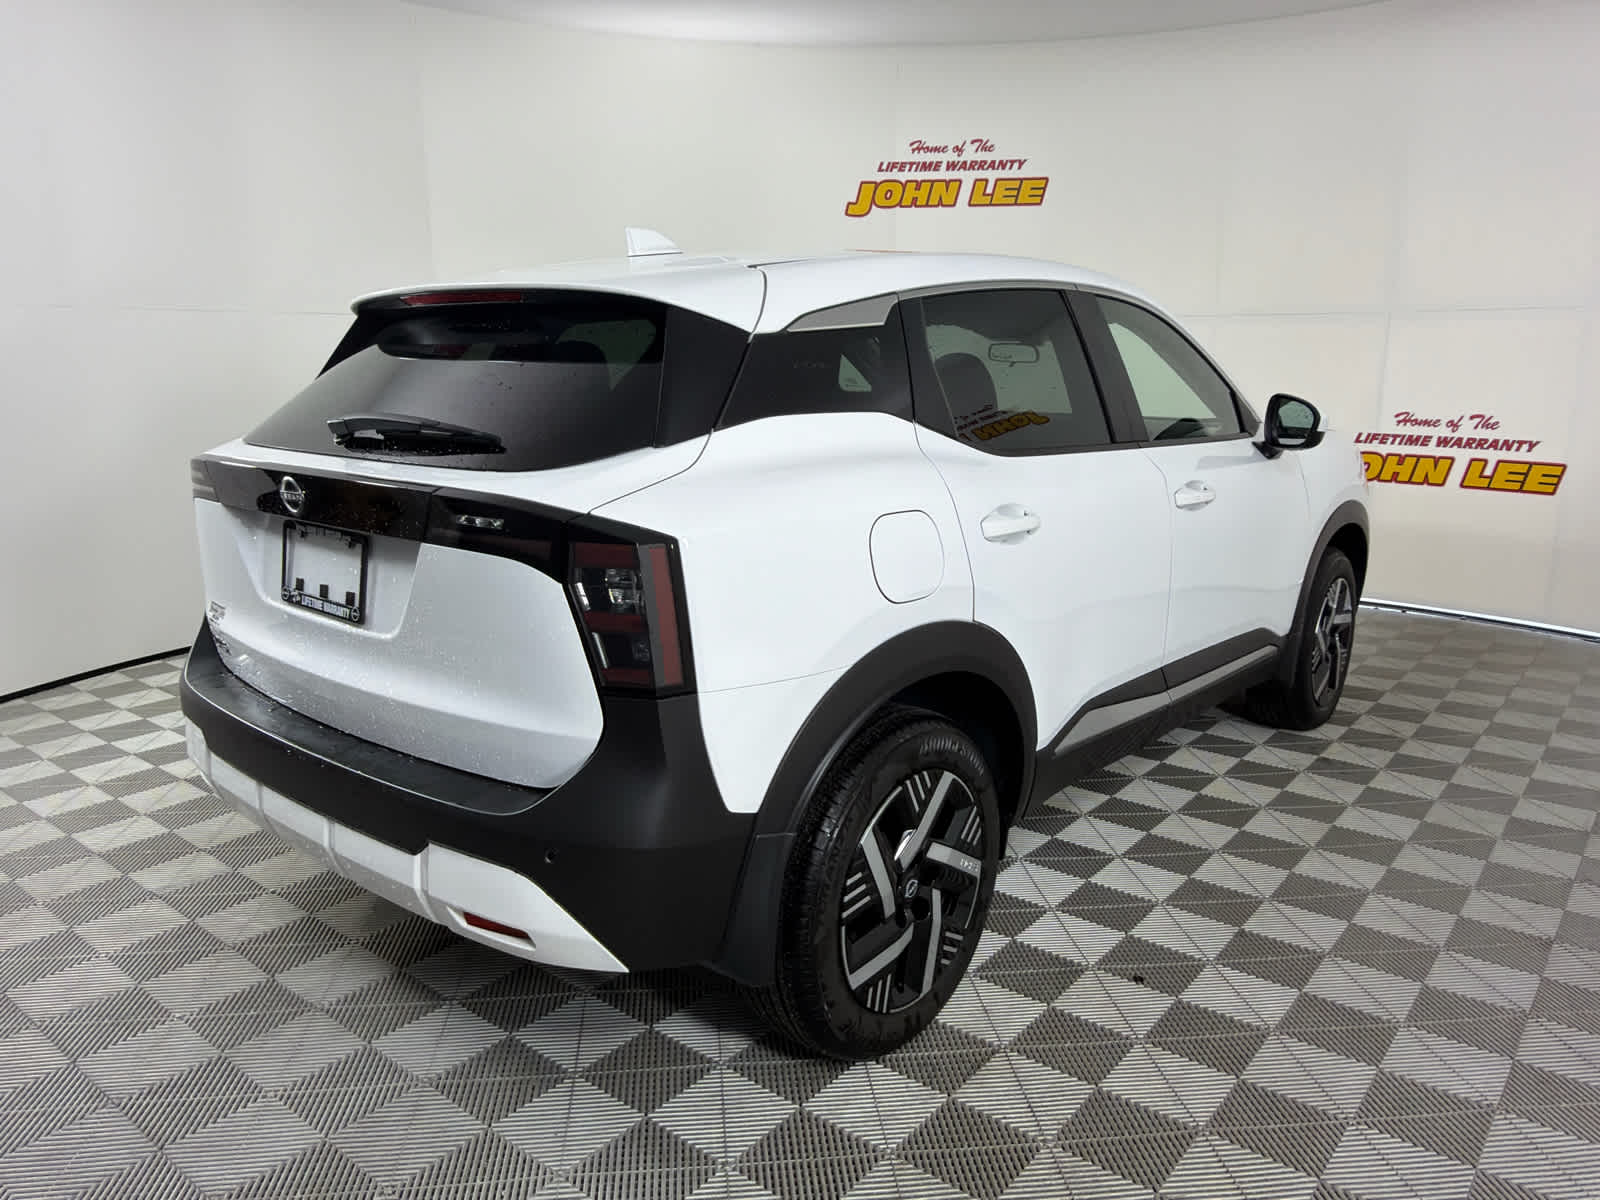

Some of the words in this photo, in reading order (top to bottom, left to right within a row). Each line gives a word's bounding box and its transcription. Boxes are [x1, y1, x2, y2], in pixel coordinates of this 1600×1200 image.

[909, 140, 949, 155] Home
[952, 140, 967, 157] of
[970, 138, 996, 153] The
[877, 161, 943, 173] LIFETIME
[945, 159, 1027, 172] WARRANTY
[845, 179, 962, 217] JOHN
[968, 177, 1049, 206] LEE
[1394, 411, 1442, 428] Home
[1446, 415, 1465, 433] of
[1469, 413, 1501, 431] The
[1354, 432, 1433, 447] LIFETIME
[1435, 436, 1540, 452] WARRANTY
[1360, 451, 1455, 486] OHN
[1459, 458, 1567, 496] LEE
